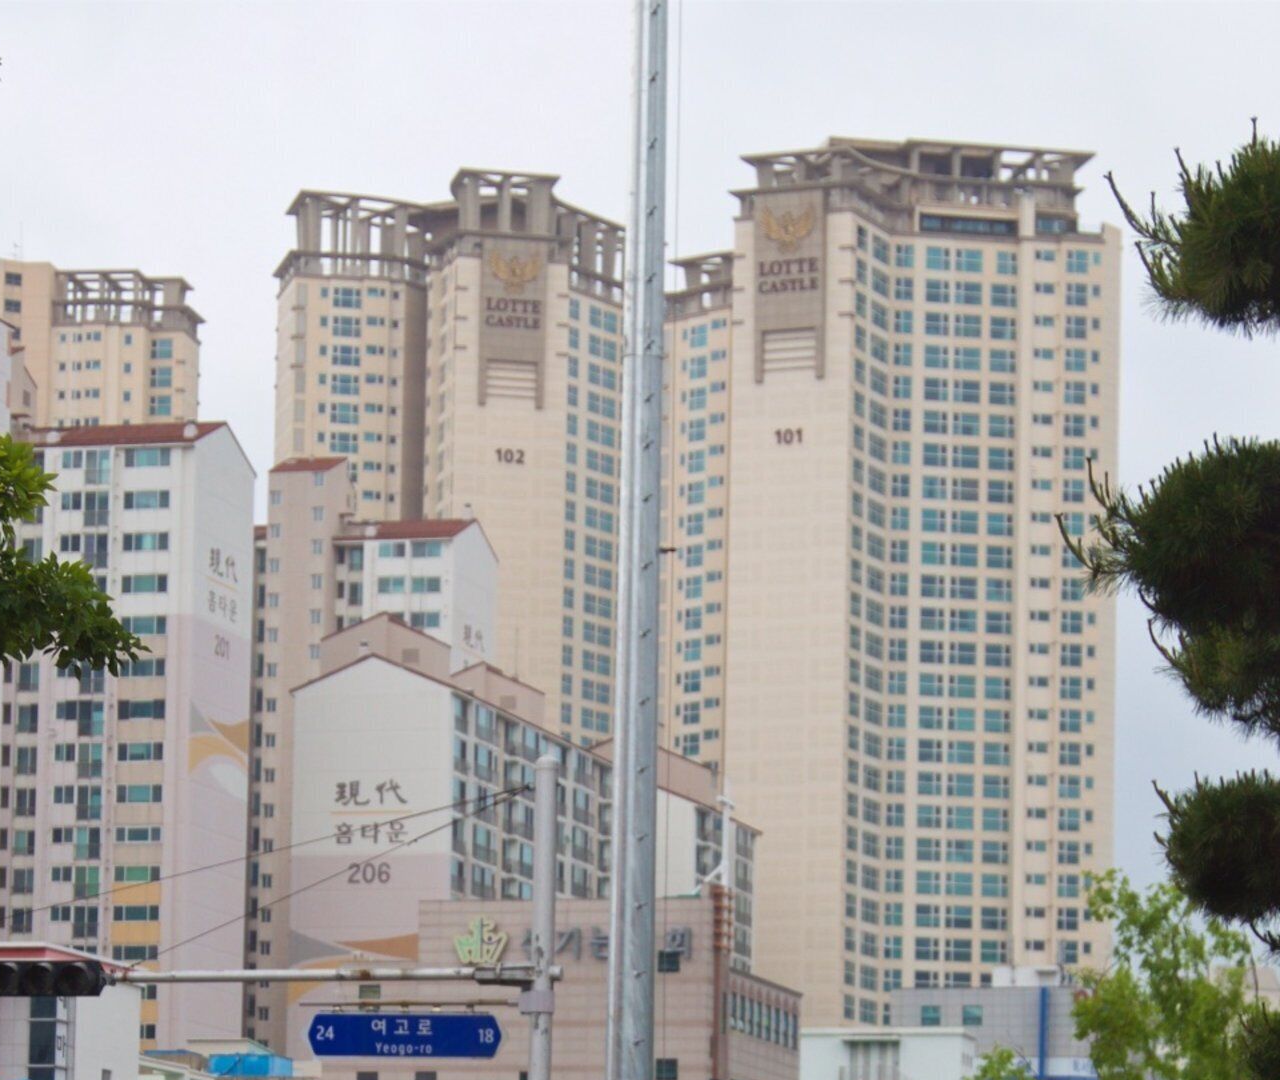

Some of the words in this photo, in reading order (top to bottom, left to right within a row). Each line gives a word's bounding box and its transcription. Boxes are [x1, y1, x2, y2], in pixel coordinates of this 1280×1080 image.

[759, 257, 818, 277] LOTTE
[758, 277, 819, 294] CASTLE
[486, 298, 542, 313] LOTTE
[485, 315, 541, 329] CASTLE
[774, 427, 803, 445] 101
[495, 448, 525, 464] 102
[214, 634, 229, 661] 201
[334, 779, 407, 806] 現代
[335, 820, 409, 844] 홈타운
[347, 862, 391, 884] 206
[316, 1025, 335, 1041] 24
[371, 1019, 433, 1035] 여고로
[478, 1028, 494, 1044] 18
[375, 1042, 433, 1056] Yeogo-ro
